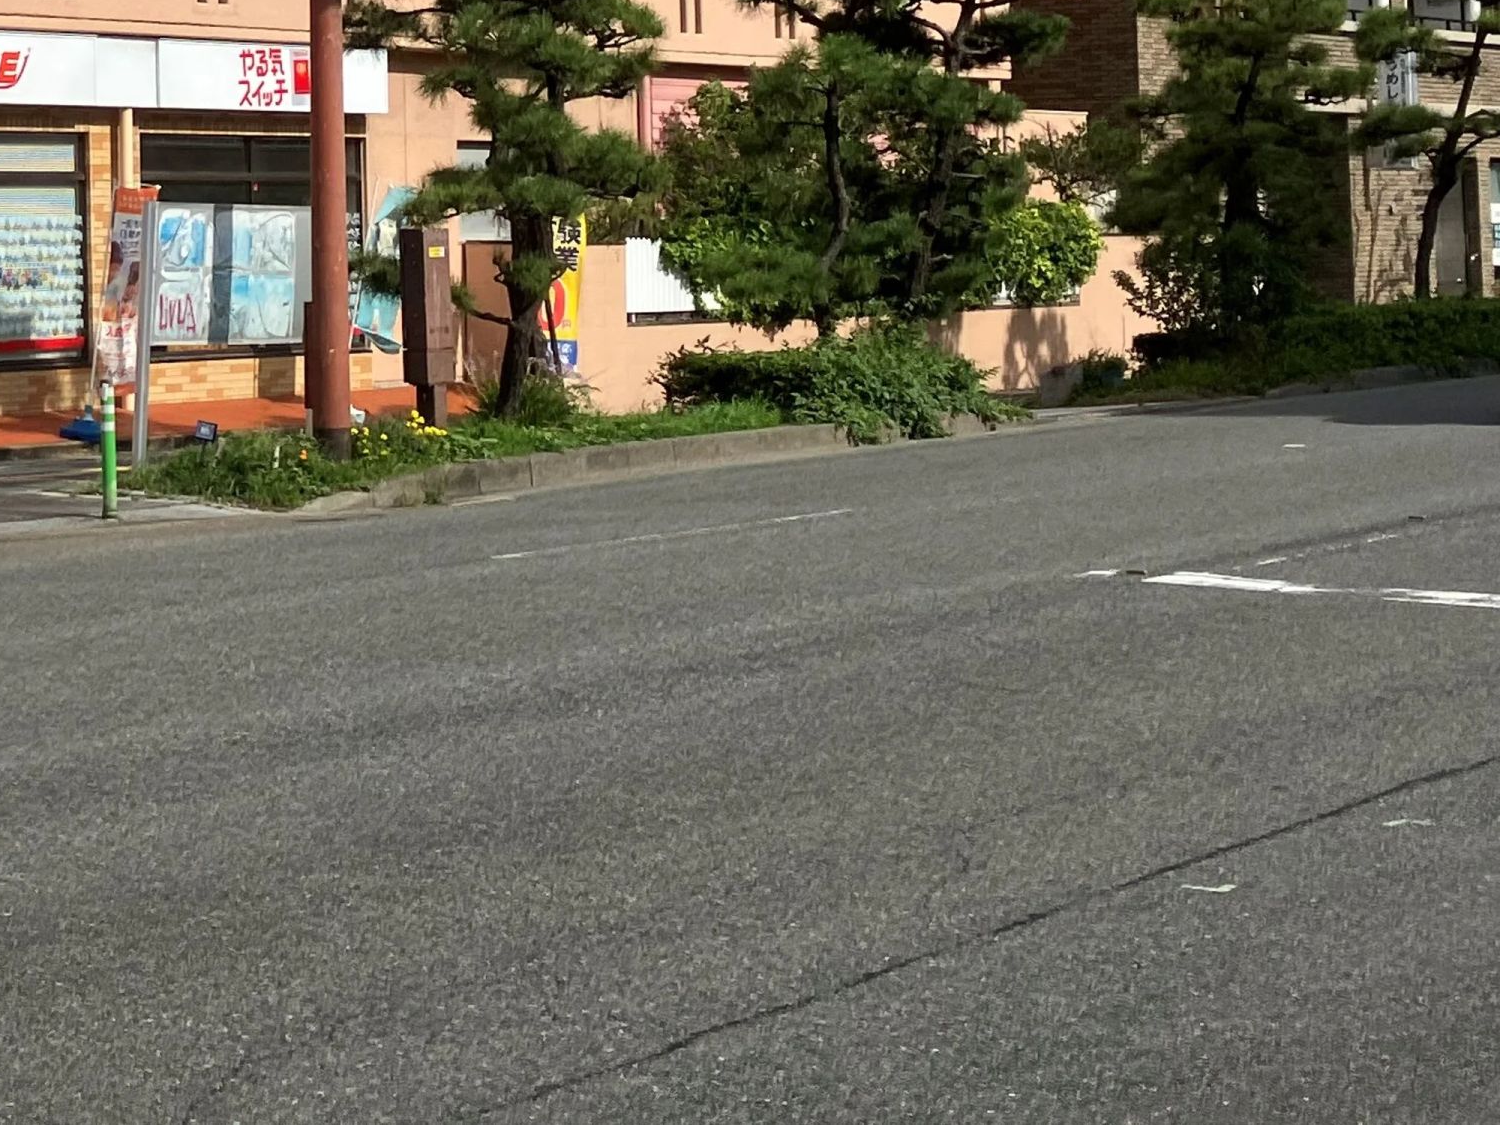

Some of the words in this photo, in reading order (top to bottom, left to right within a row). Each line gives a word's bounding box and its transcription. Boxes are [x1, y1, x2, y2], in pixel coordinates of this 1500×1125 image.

[239, 48, 285, 78] やる気
[238, 79, 288, 107] スイッチ
